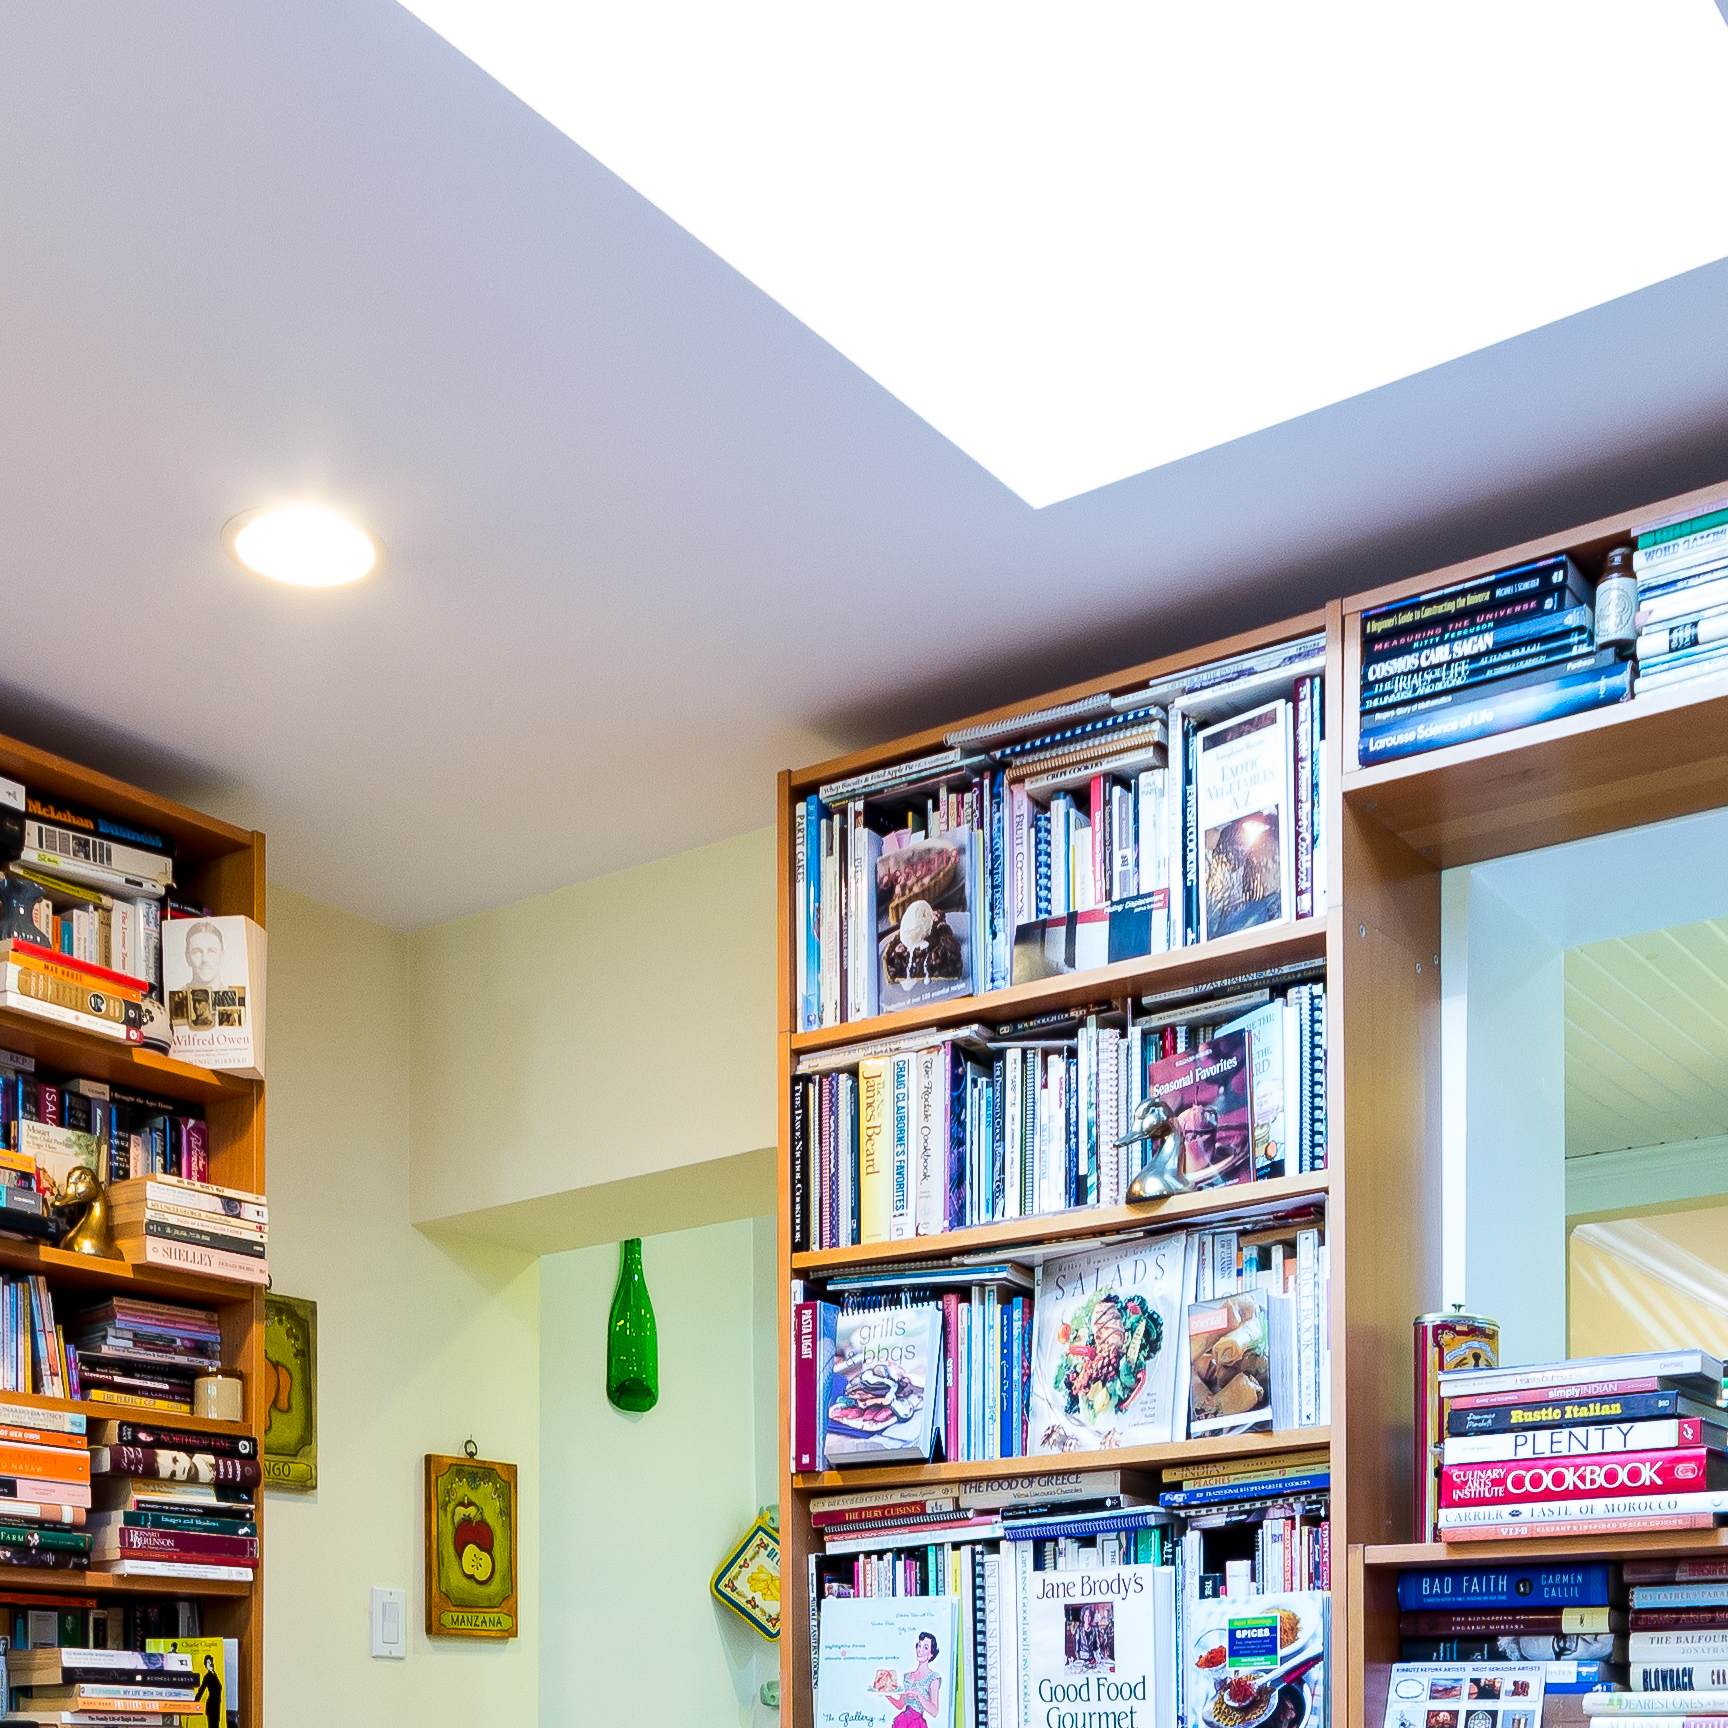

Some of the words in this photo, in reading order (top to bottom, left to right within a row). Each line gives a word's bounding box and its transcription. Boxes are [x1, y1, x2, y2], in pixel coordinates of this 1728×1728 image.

[1368, 661, 1418, 682] COSMOS
[1421, 648, 1453, 669] CARL
[1455, 635, 1494, 657] SAGAN
[26, 798, 94, 830] McLuhan
[98, 817, 163, 847] Business
[172, 1034, 213, 1047] Wilfred
[217, 1032, 250, 1046] Owen
[1153, 1070, 1193, 1098] Seasonal
[1197, 1056, 1237, 1083] Favorites
[861, 1069, 881, 1122] James
[864, 1124, 881, 1177] Beard
[161, 1246, 214, 1266] SHELLEY
[1055, 1255, 1167, 1299] SALADS
[859, 1319, 906, 1340] grills
[861, 1345, 916, 1364] bbqs
[1510, 1406, 1561, 1424] Rustic
[1564, 1401, 1622, 1420] Italian
[1513, 1425, 1635, 1459] PLENTY
[1507, 1461, 1662, 1493] COOKBOOK
[1036, 1578, 1076, 1601] Jane
[1082, 1574, 1143, 1600] Brody's
[1421, 1577, 1452, 1593] BAD
[1460, 1573, 1508, 1591] FAITH
[450, 1612, 503, 1628] MANZANA
[1235, 1627, 1270, 1638] SPICES
[1038, 1679, 1090, 1703] Good
[1096, 1677, 1146, 1702] Food
[1643, 1666, 1694, 1691] BLOWBACK
